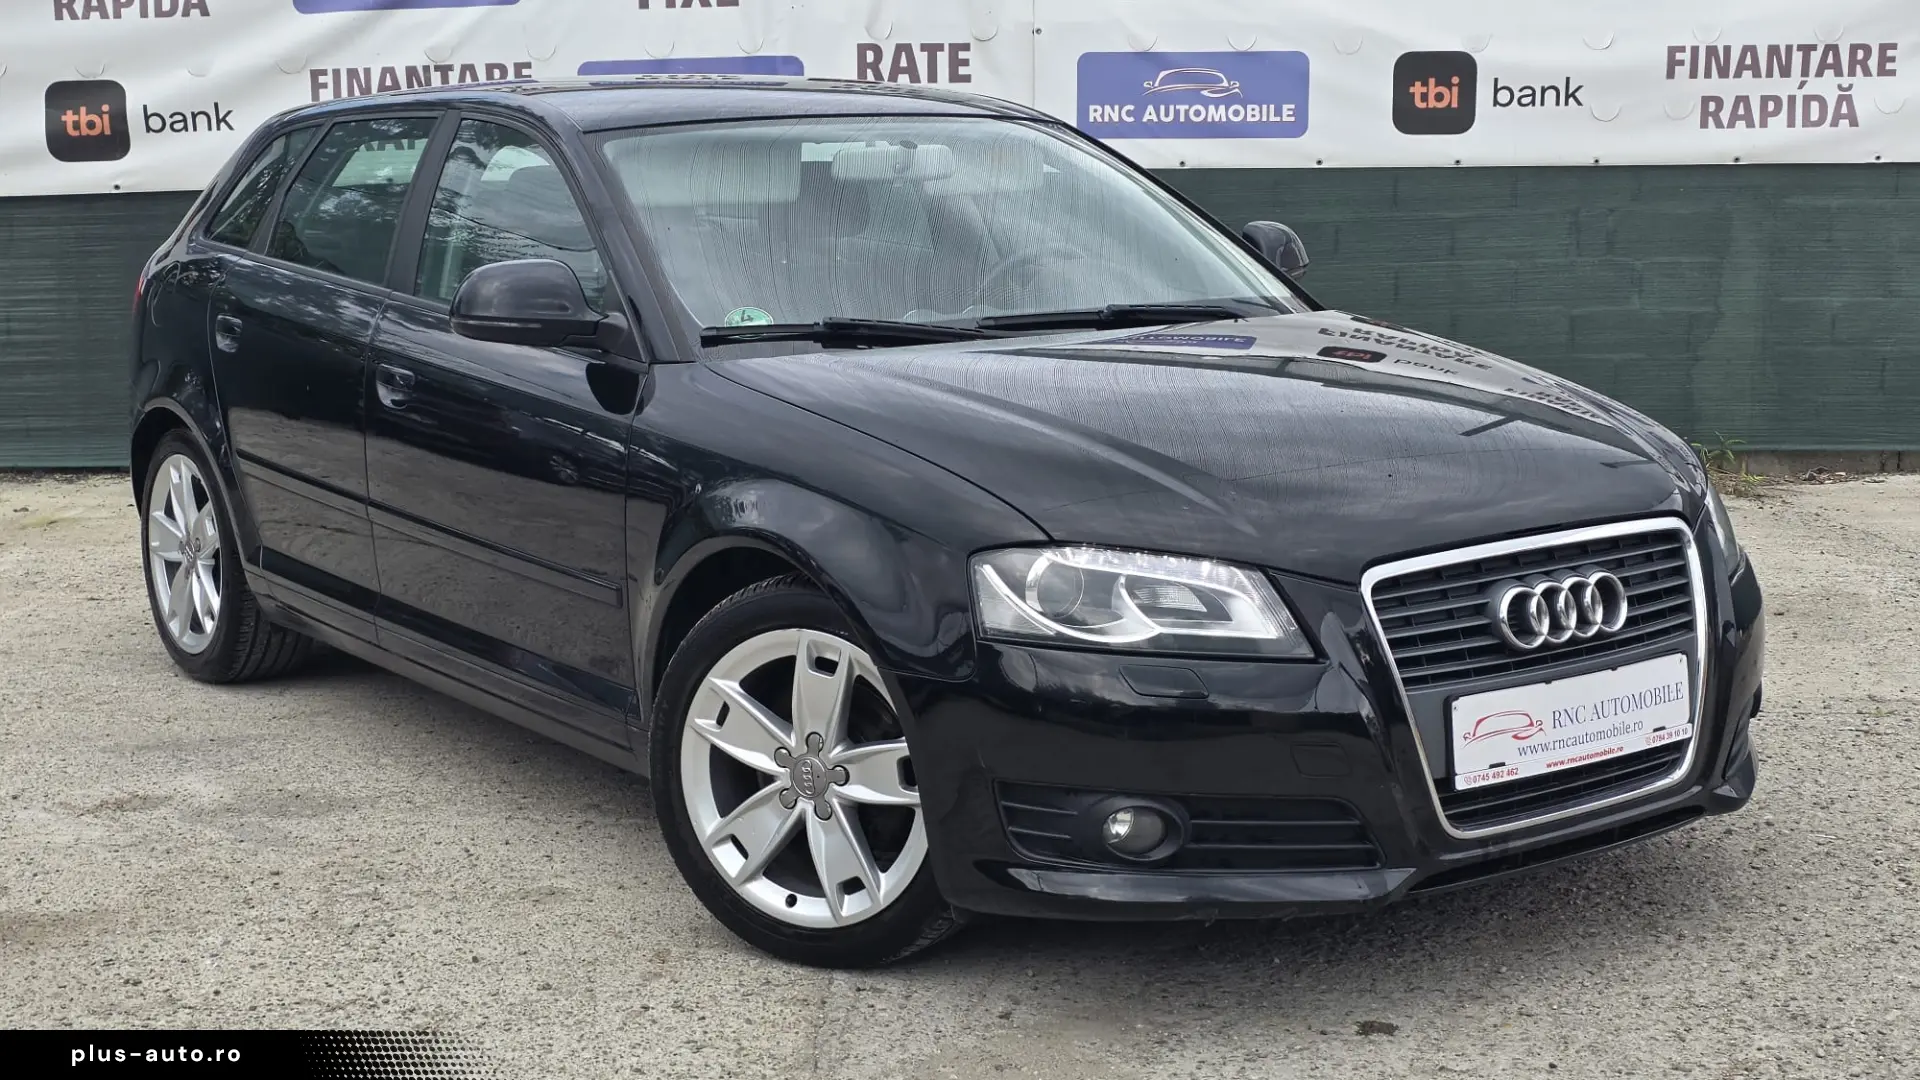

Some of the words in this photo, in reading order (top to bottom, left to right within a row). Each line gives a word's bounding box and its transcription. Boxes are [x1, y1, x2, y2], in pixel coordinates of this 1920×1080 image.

[857, 43, 972, 84] RATE
[1409, 76, 1460, 108] tbi
[1492, 76, 1584, 107] bank
[61, 104, 111, 137] tbi
[142, 102, 235, 133] bank
[1089, 105, 1135, 122] RNC
[1142, 105, 1296, 122] AUTOMOBILE
[1552, 705, 1586, 729] RNC
[1590, 682, 1684, 721] AUTOMOBILE
[1518, 720, 1644, 757] www.rncautomobile.ro
[1674, 729, 1681, 738] 10
[1546, 746, 1624, 769] www.rncautomobile.ro
[1472, 772, 1490, 784] 0745
[1491, 770, 1504, 780] 492
[1506, 767, 1519, 777] 462
